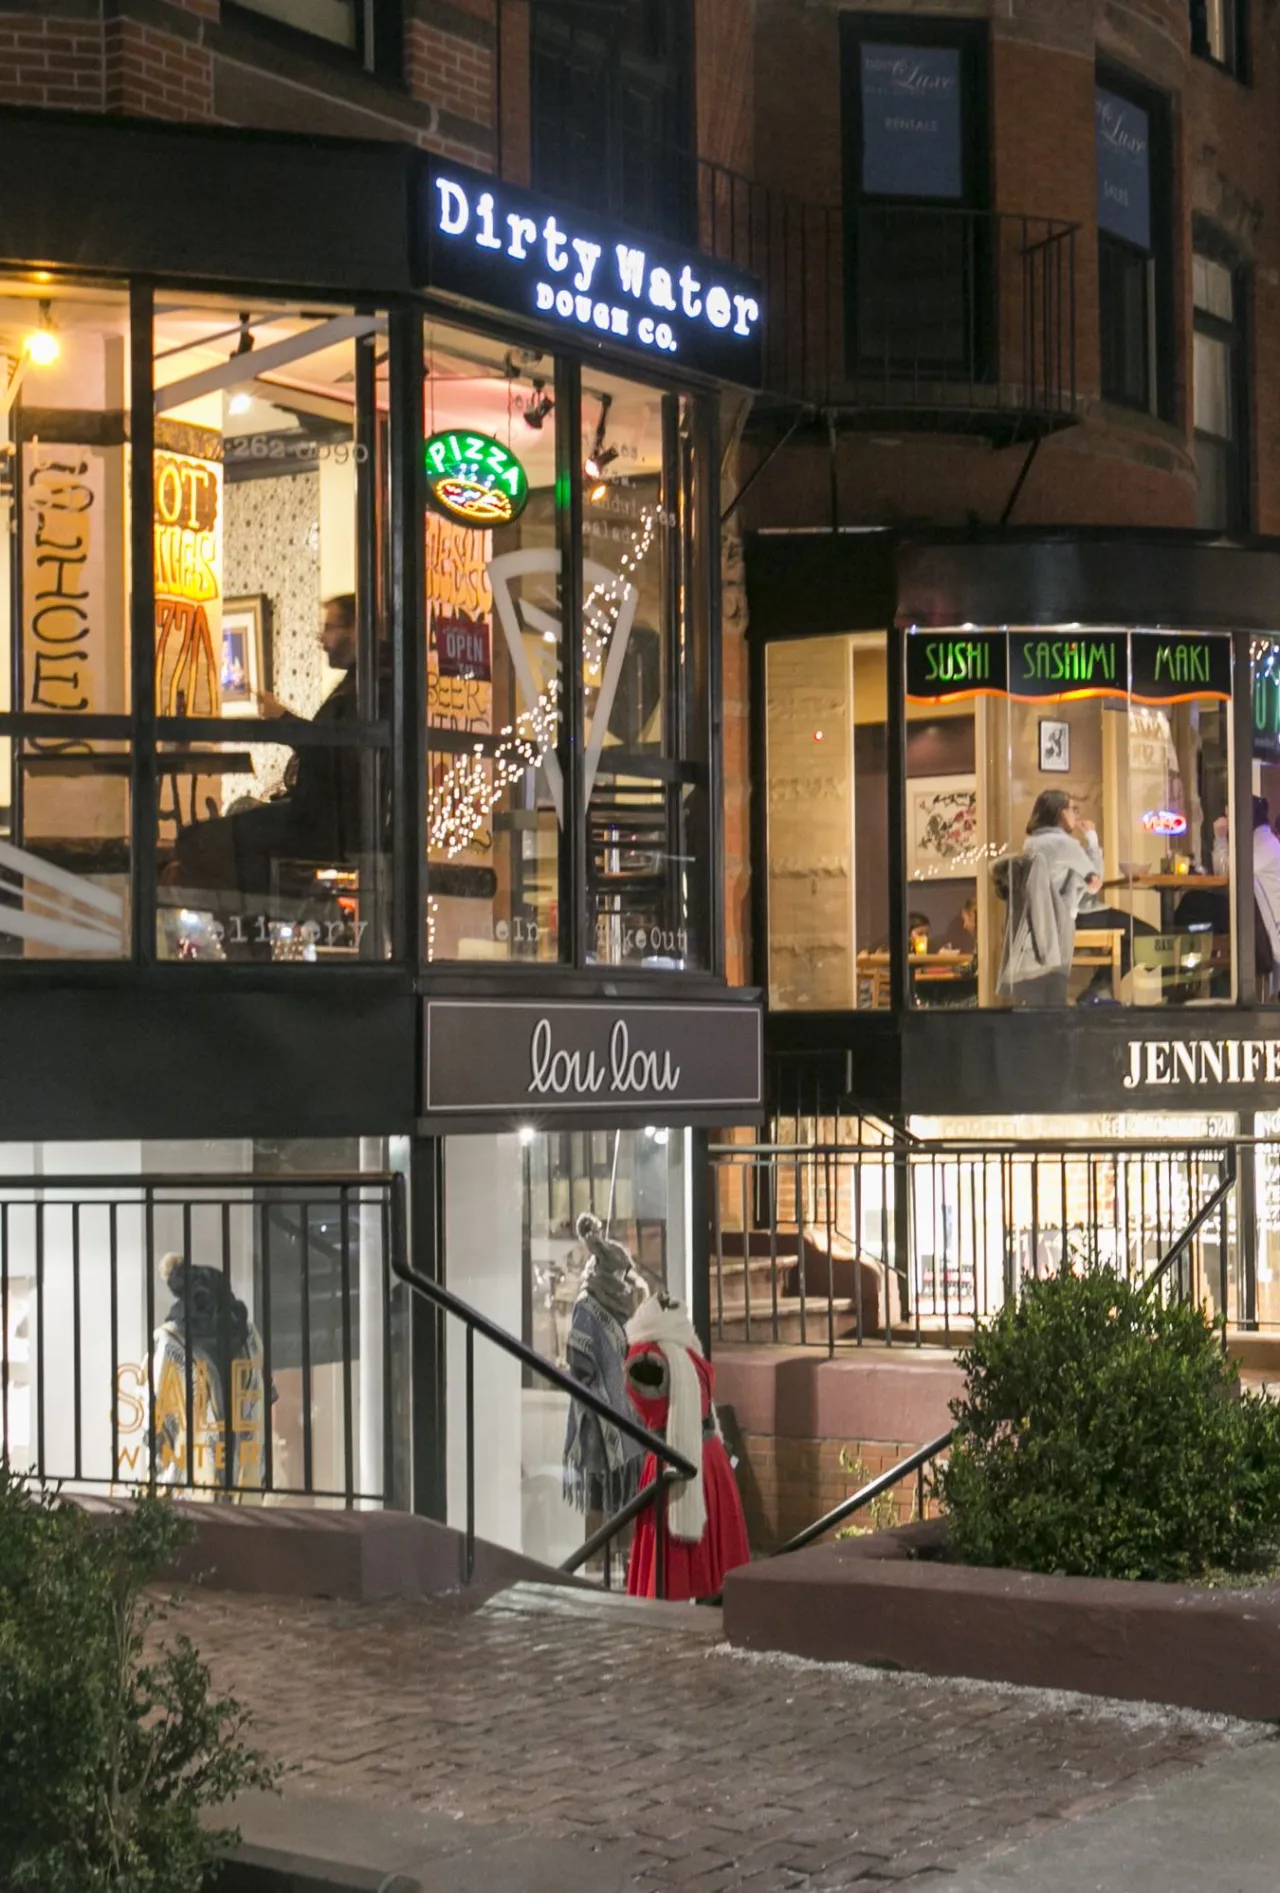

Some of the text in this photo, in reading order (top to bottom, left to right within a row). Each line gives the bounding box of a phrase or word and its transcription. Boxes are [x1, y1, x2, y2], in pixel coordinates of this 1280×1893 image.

[436, 177, 759, 336] Dirty Water
[428, 435, 521, 496] PIZZA
[446, 634, 483, 663] OPEN
[925, 642, 989, 680] SUSHI
[1023, 641, 1115, 680] SASHIMI
[1154, 644, 1210, 682] MAKI
[528, 1018, 681, 1093] lou lou
[110, 1359, 262, 1434] SALE
